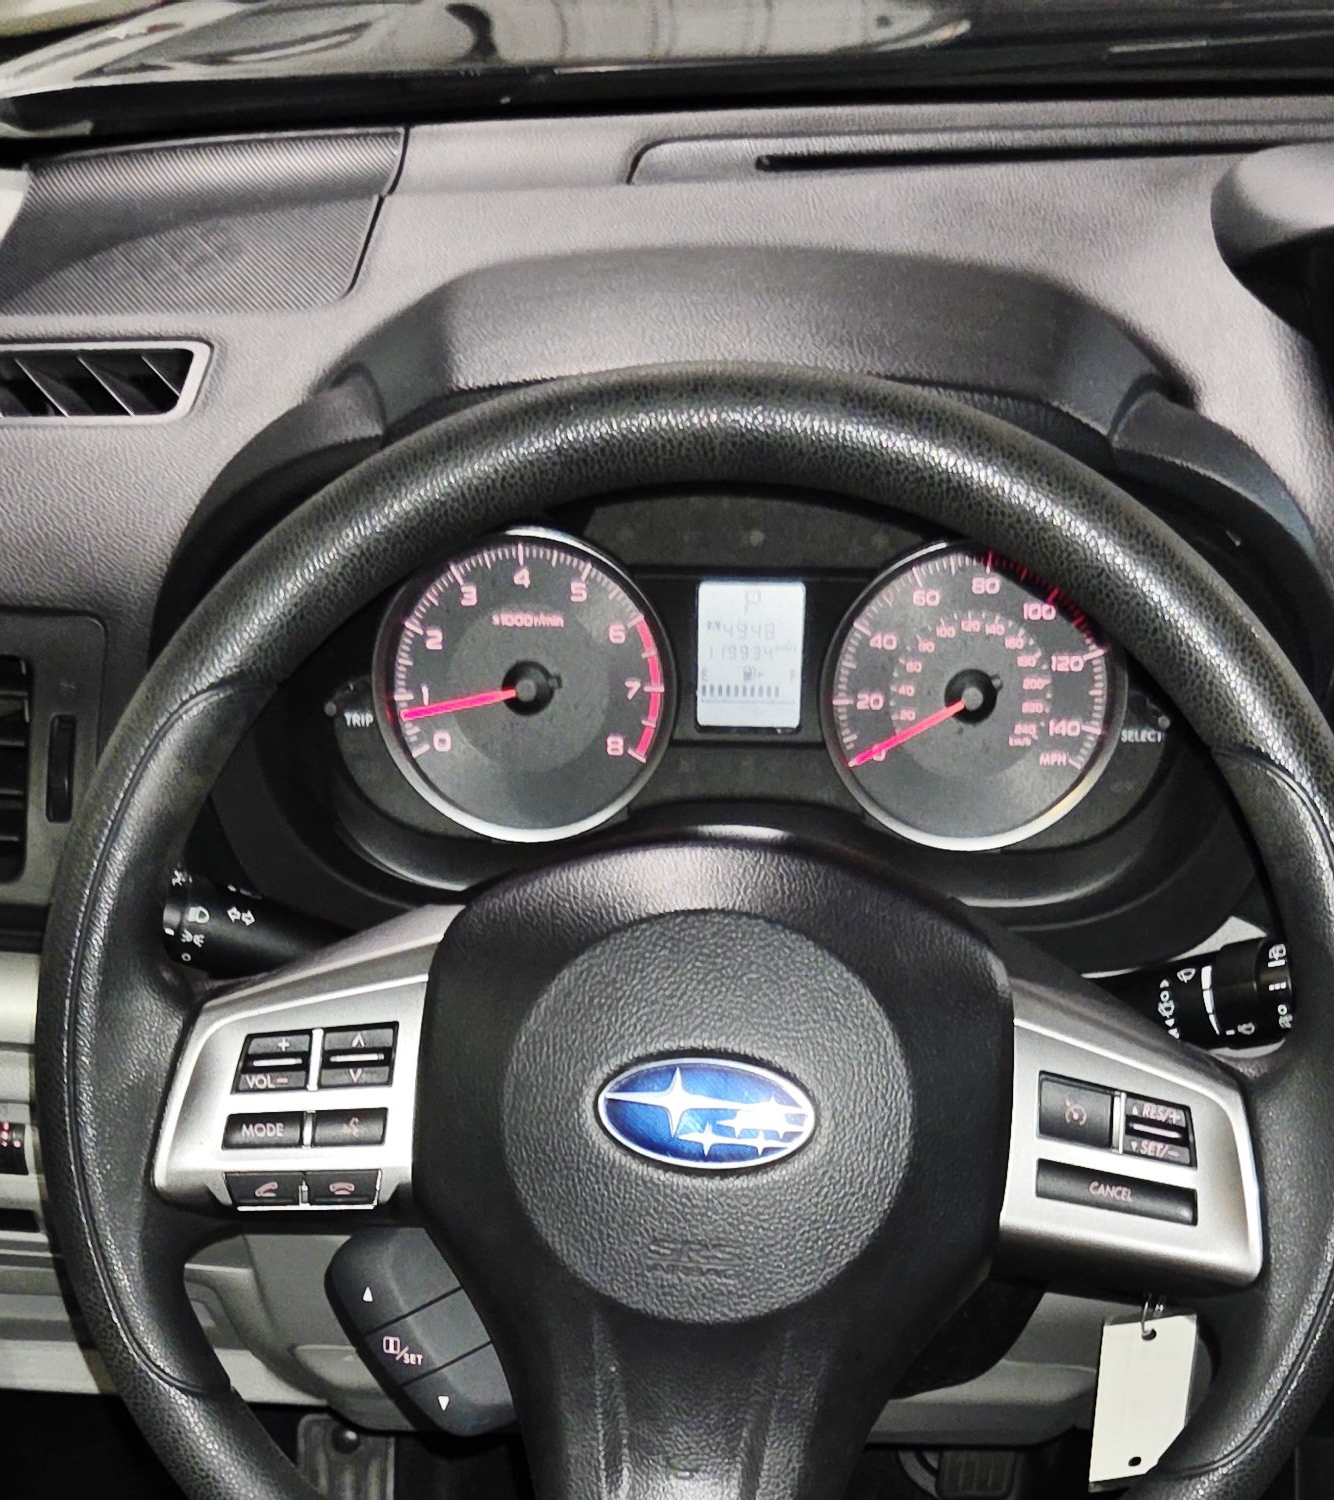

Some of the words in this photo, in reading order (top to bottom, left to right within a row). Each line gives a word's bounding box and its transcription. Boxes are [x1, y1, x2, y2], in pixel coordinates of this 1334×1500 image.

[513, 568, 530, 588] 4
[971, 577, 999, 594] 80
[460, 586, 477, 606] 3
[570, 582, 587, 602] 5
[912, 589, 940, 606] 60
[745, 590, 761, 615] P
[1023, 603, 1056, 620] 100
[426, 630, 443, 650] 2
[608, 624, 626, 644] 6
[869, 633, 897, 650] 40
[1051, 655, 1084, 672] 120
[422, 685, 430, 706] 1
[624, 680, 641, 700] 7
[898, 685, 915, 696] 40
[856, 693, 884, 710] 20
[344, 711, 374, 728] TRIP
[1049, 719, 1081, 737] 140
[433, 732, 451, 752] 0
[1121, 729, 1162, 742] SELECT
[606, 735, 624, 756] 8
[1039, 752, 1066, 767] MPH
[241, 1123, 284, 1137] MODE
[1090, 1181, 1132, 1201] CANCEL
